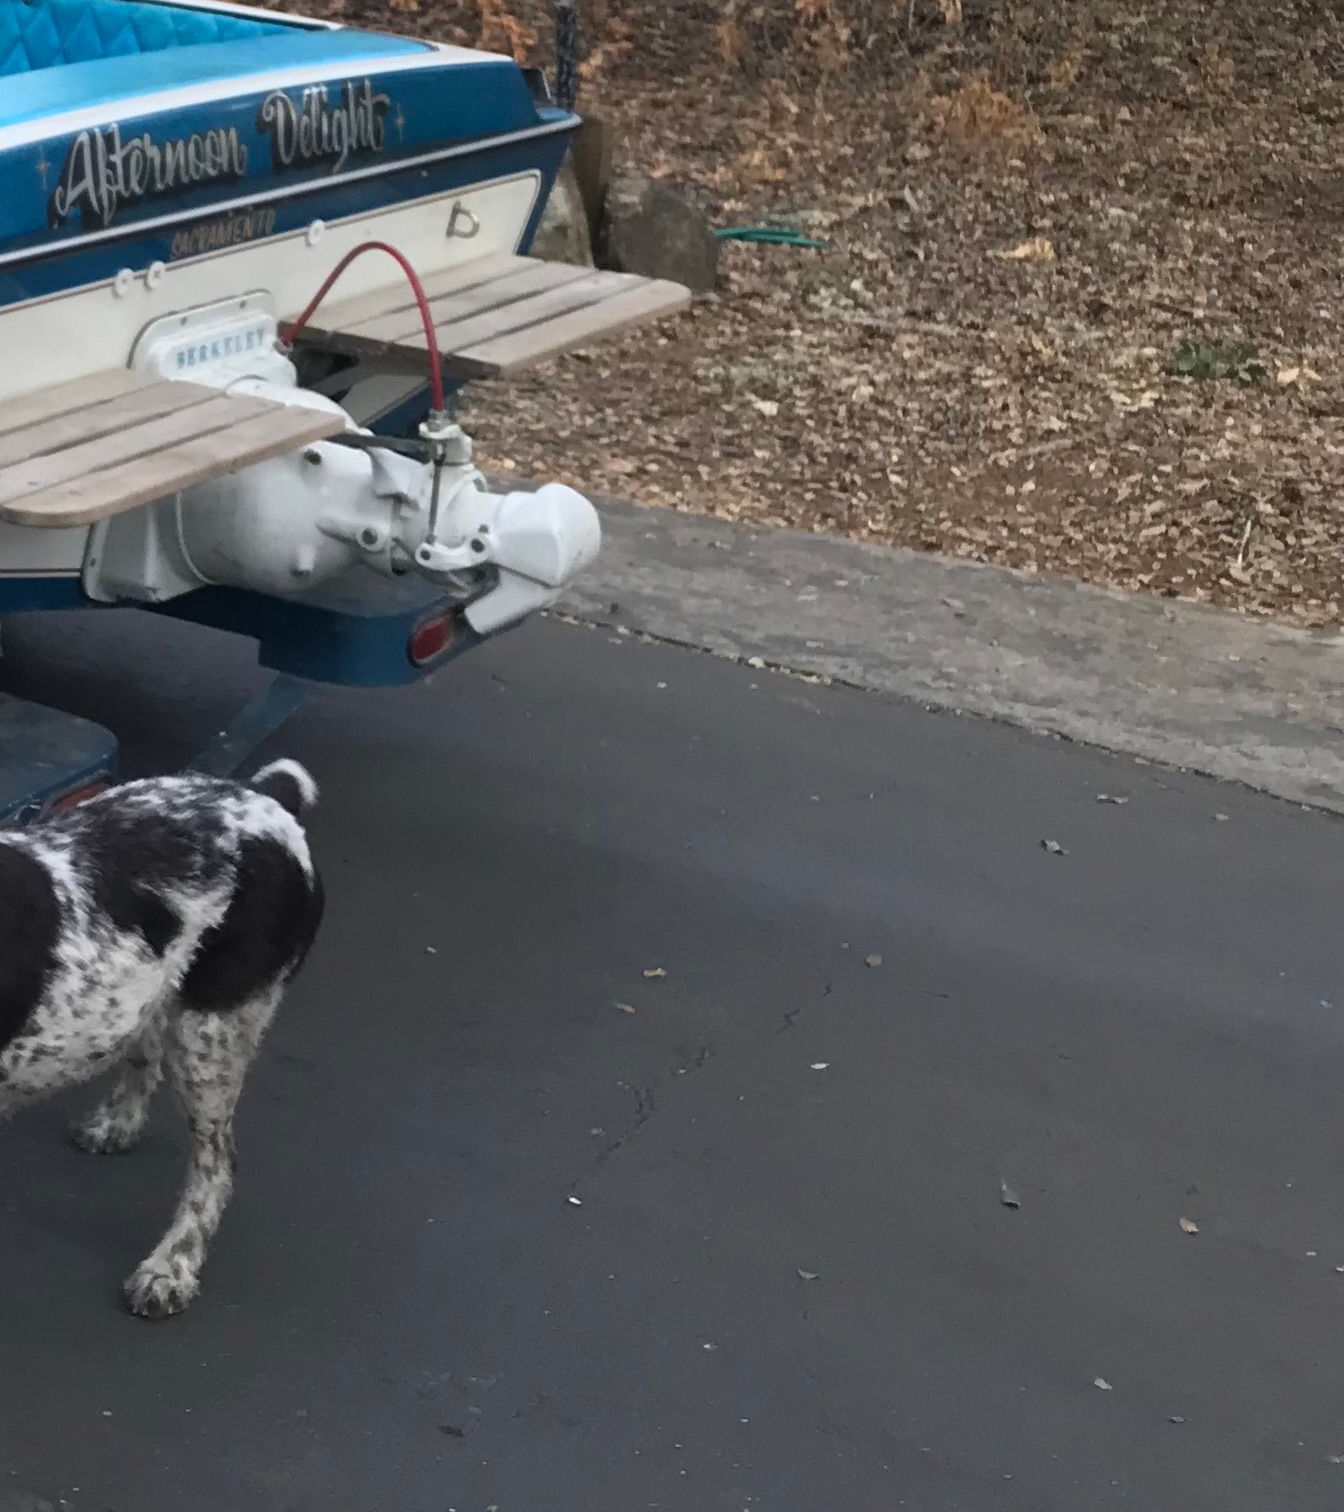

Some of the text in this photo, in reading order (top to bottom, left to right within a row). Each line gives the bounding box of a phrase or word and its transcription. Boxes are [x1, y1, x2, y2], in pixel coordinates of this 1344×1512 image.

[55, 77, 390, 226] Afternoon Delight
[176, 327, 266, 369] BERKELEY
